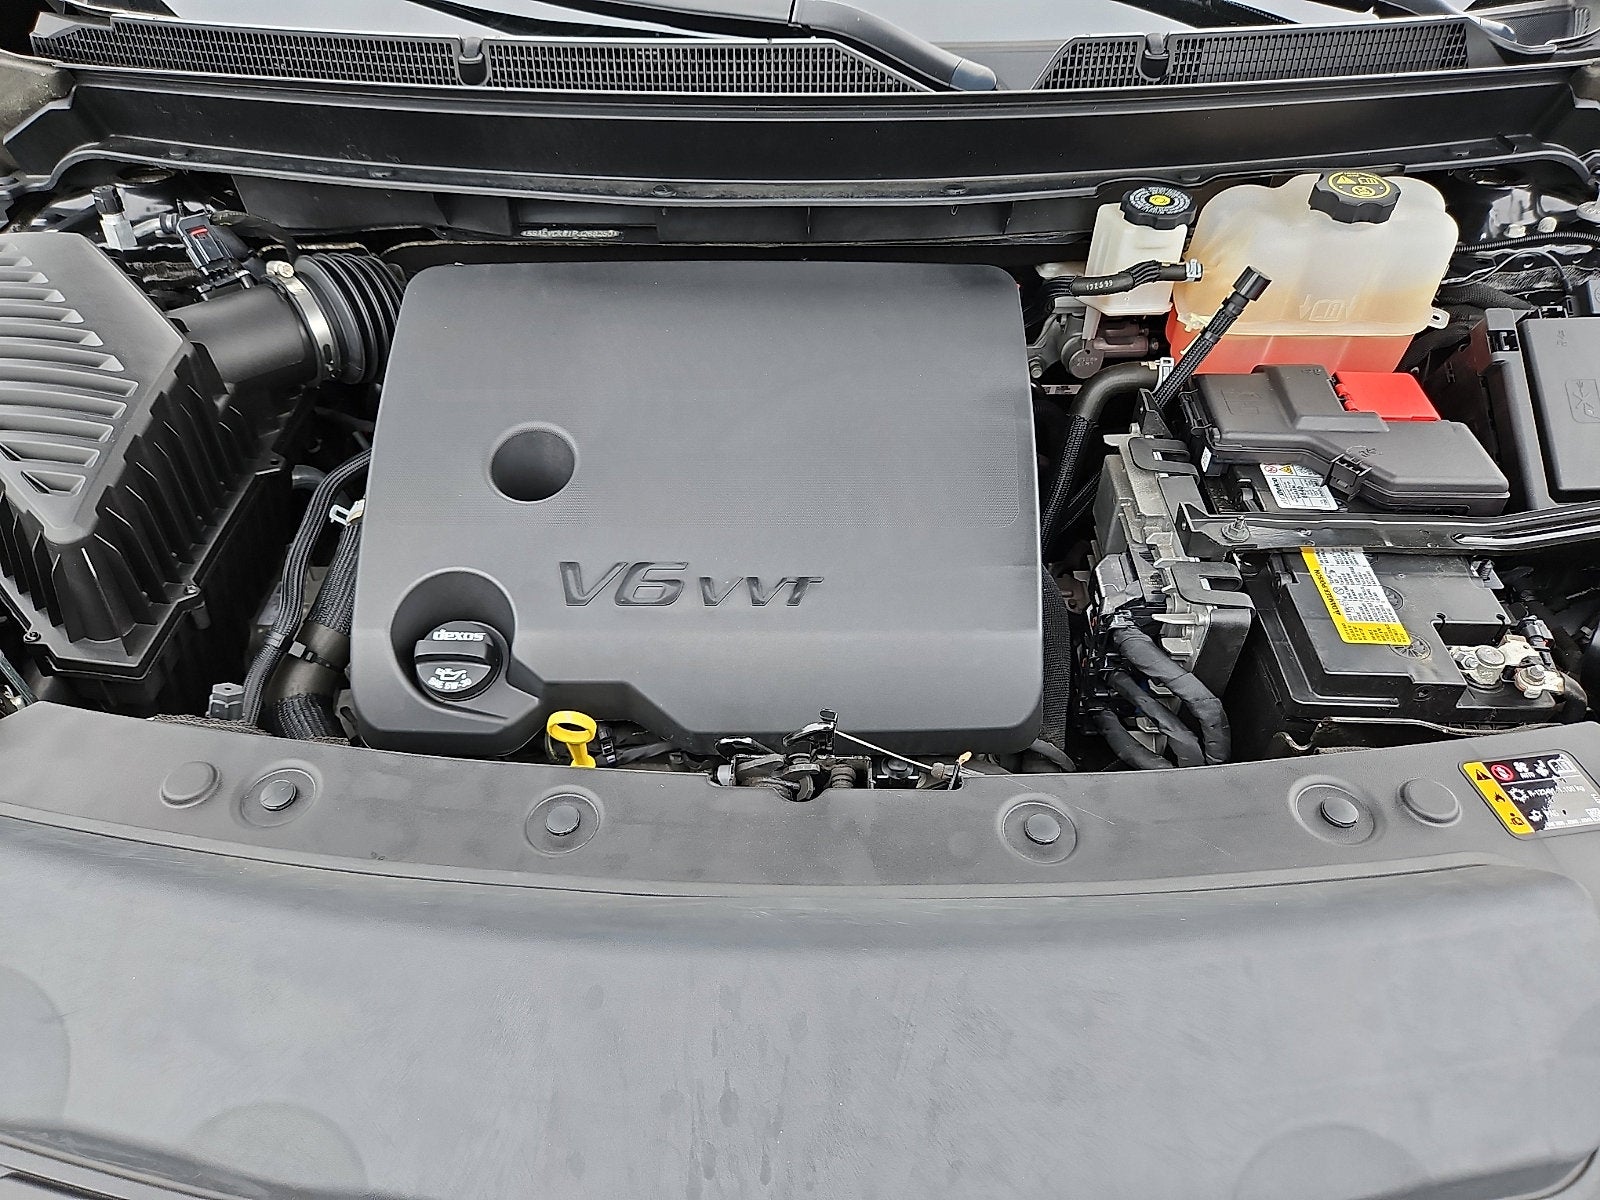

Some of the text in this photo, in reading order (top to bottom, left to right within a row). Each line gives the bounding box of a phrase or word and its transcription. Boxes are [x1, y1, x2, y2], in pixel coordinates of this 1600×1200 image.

[559, 561, 824, 606] V6 VVT
[433, 629, 486, 641] dexos
